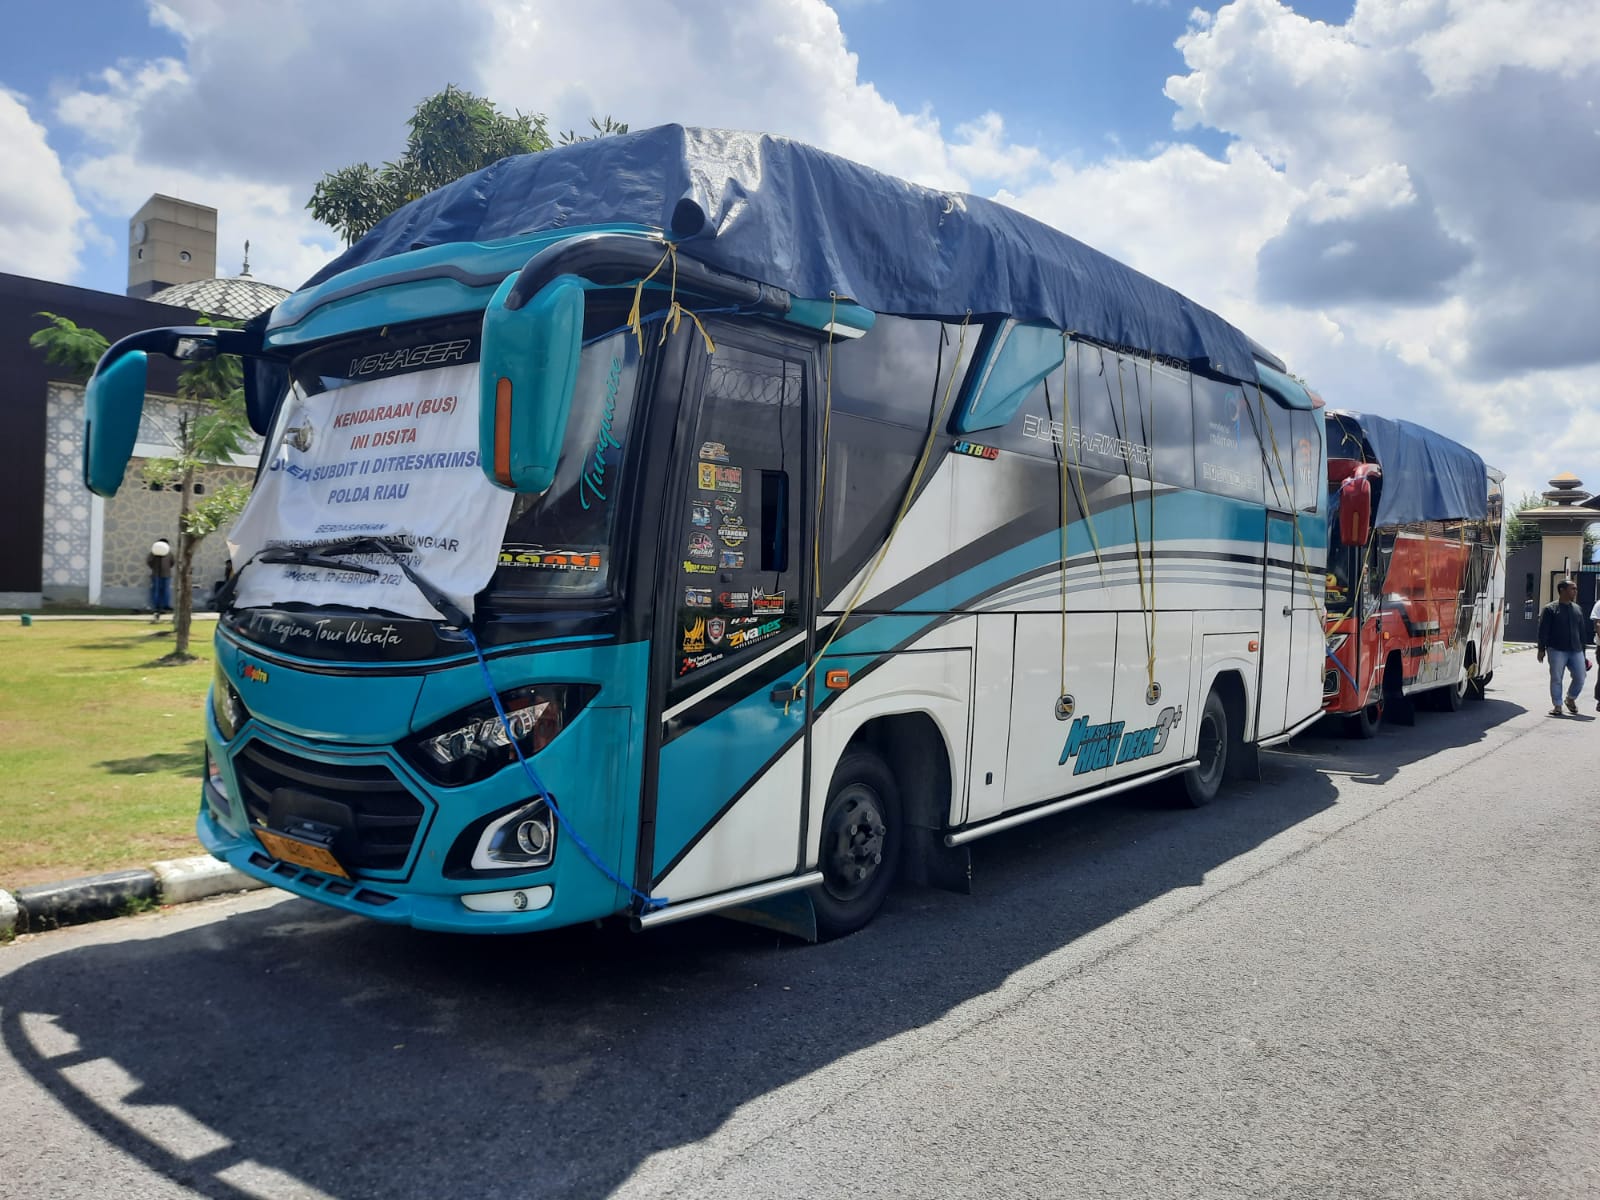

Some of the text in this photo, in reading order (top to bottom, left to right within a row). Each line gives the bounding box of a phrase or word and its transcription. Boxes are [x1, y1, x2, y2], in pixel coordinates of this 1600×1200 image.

[349, 340, 471, 377] VOYAGER
[333, 396, 458, 429] KENDARAAN (BUS)
[350, 428, 417, 450] INI DISITA
[1023, 414, 1064, 444] BUS
[954, 440, 999, 459] JETBUS
[312, 461, 358, 481] SUBDIT
[327, 483, 409, 504] POLDA RIAU
[269, 617, 313, 643] Regina
[314, 619, 345, 641] Tour
[345, 621, 403, 648] Wisata
[1115, 726, 1160, 765] DECK
